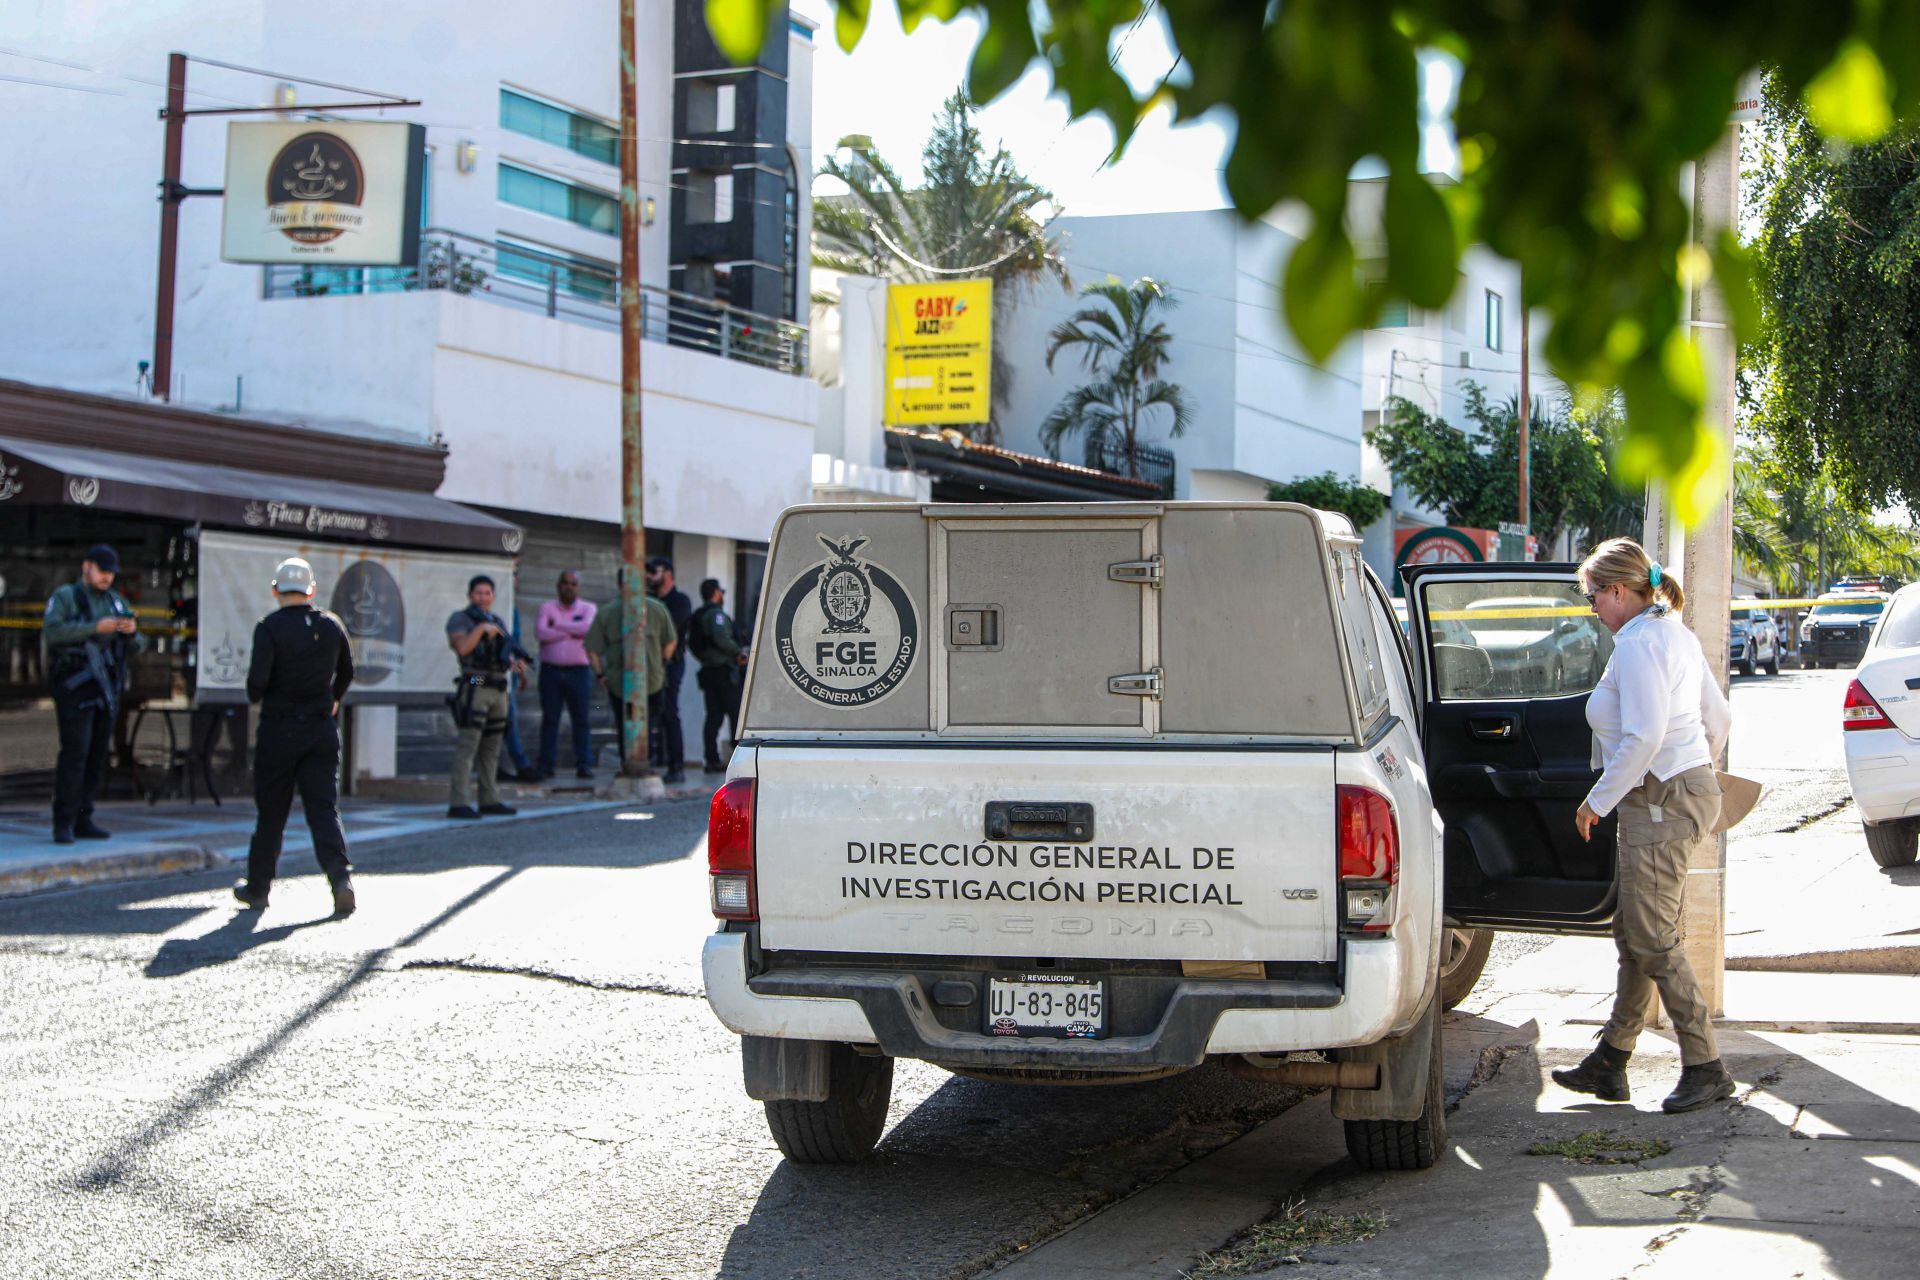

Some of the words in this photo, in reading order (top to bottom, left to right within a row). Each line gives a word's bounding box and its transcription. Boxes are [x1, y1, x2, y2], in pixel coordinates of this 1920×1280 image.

[816, 641, 877, 665] FGE
[781, 637, 808, 688] FISCALÍA
[811, 685, 866, 703] GENERAL
[867, 681, 890, 698] DEL
[888, 636, 912, 682] ESTADO
[816, 666, 877, 677] SINALOA
[1015, 810, 1064, 820] TOYOTA
[847, 839, 1017, 867] DIRECCIÓN
[1030, 846, 1181, 869] GENERAL
[1193, 847, 1235, 869] DE
[841, 876, 1084, 903] INVESTIGACIÓN
[1097, 882, 1243, 905] PERICIAL
[1282, 888, 1319, 900] V6
[881, 912, 1213, 937] TACOMA
[1027, 974, 1074, 982] REVOLUCION
[991, 990, 1101, 1018] UJ-83-845
